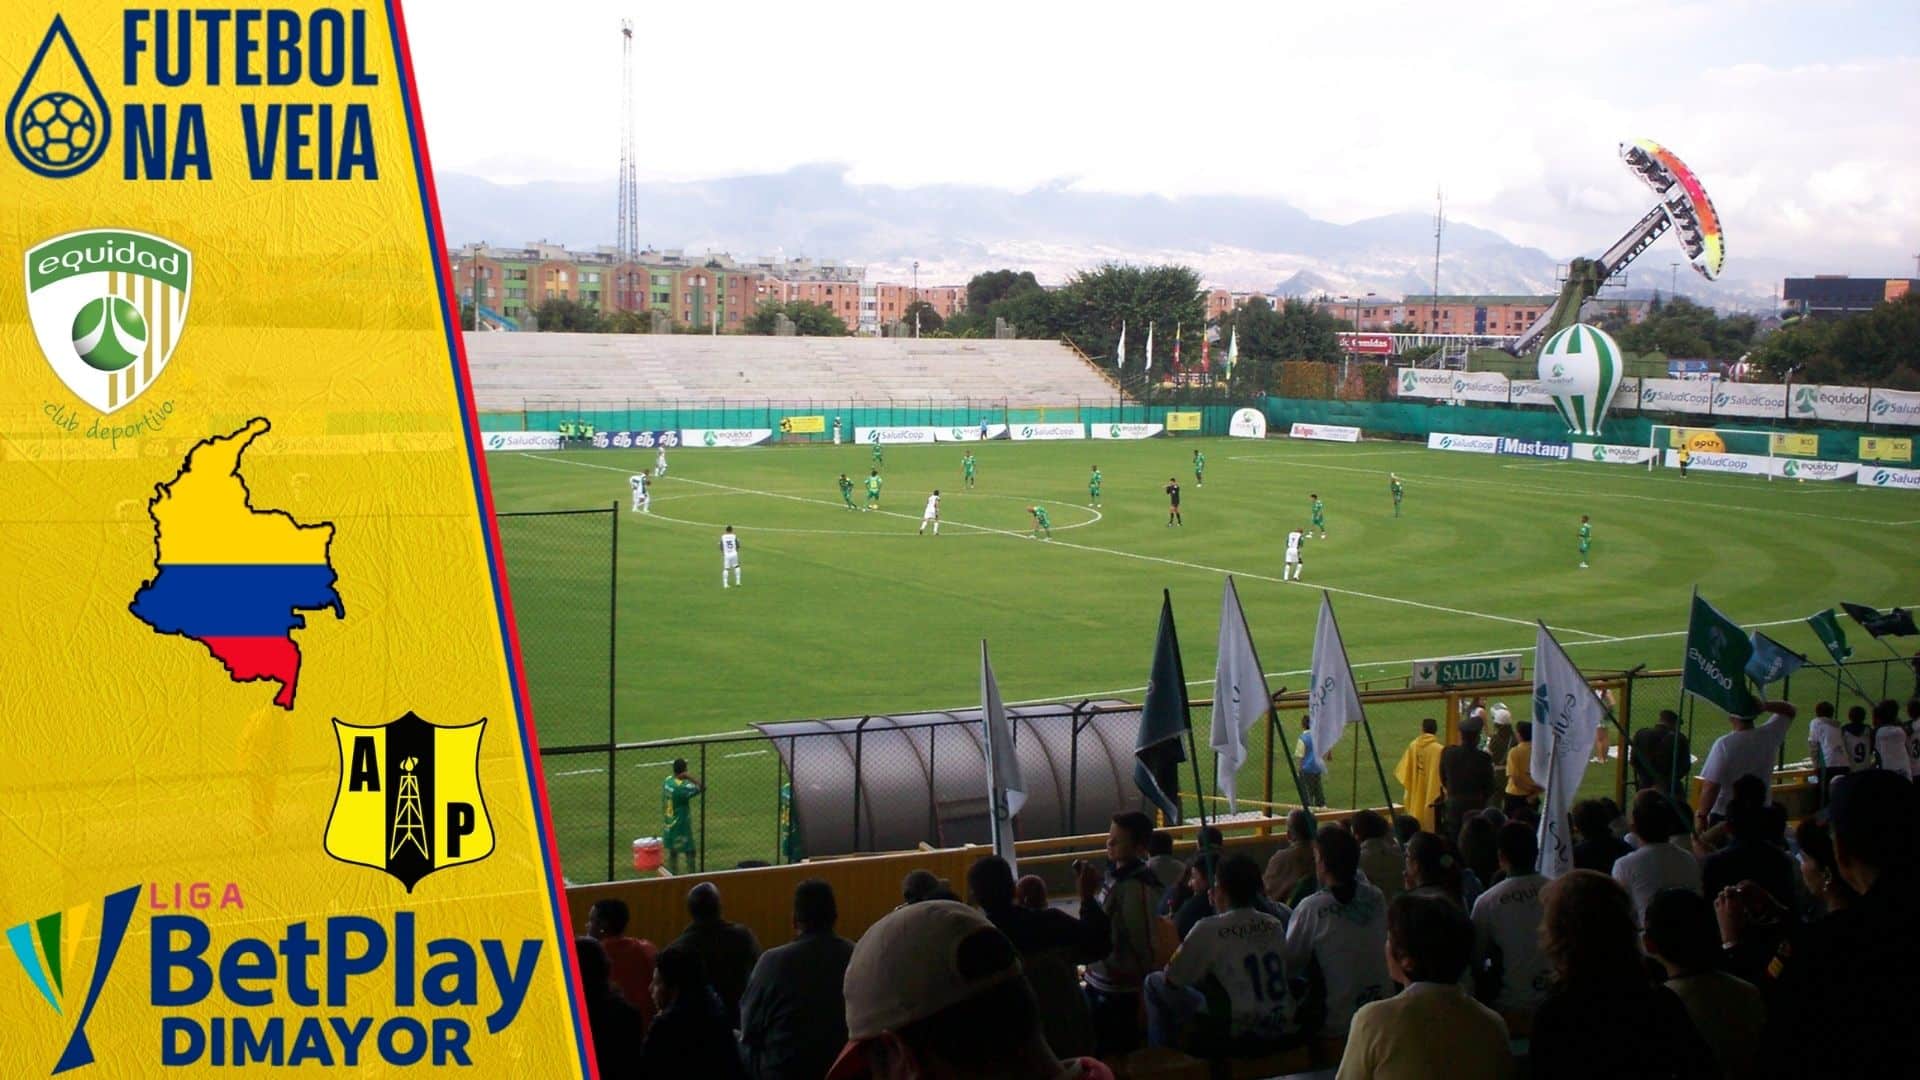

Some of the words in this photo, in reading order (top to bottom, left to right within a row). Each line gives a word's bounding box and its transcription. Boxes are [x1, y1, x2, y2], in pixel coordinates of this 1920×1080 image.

[1656, 389, 1709, 405] SaludCoop
[1731, 394, 1785, 409] SaludCoop
[1820, 392, 1867, 405] equidad
[882, 430, 925, 442] SaludCoop
[1504, 438, 1569, 460] Mustang
[1695, 454, 1748, 471] SaludCoop
[1801, 461, 1839, 473] equidad
[1443, 662, 1497, 682] SALIDA
[1854, 742, 1866, 763] 9
[1244, 952, 1286, 1001] 18
